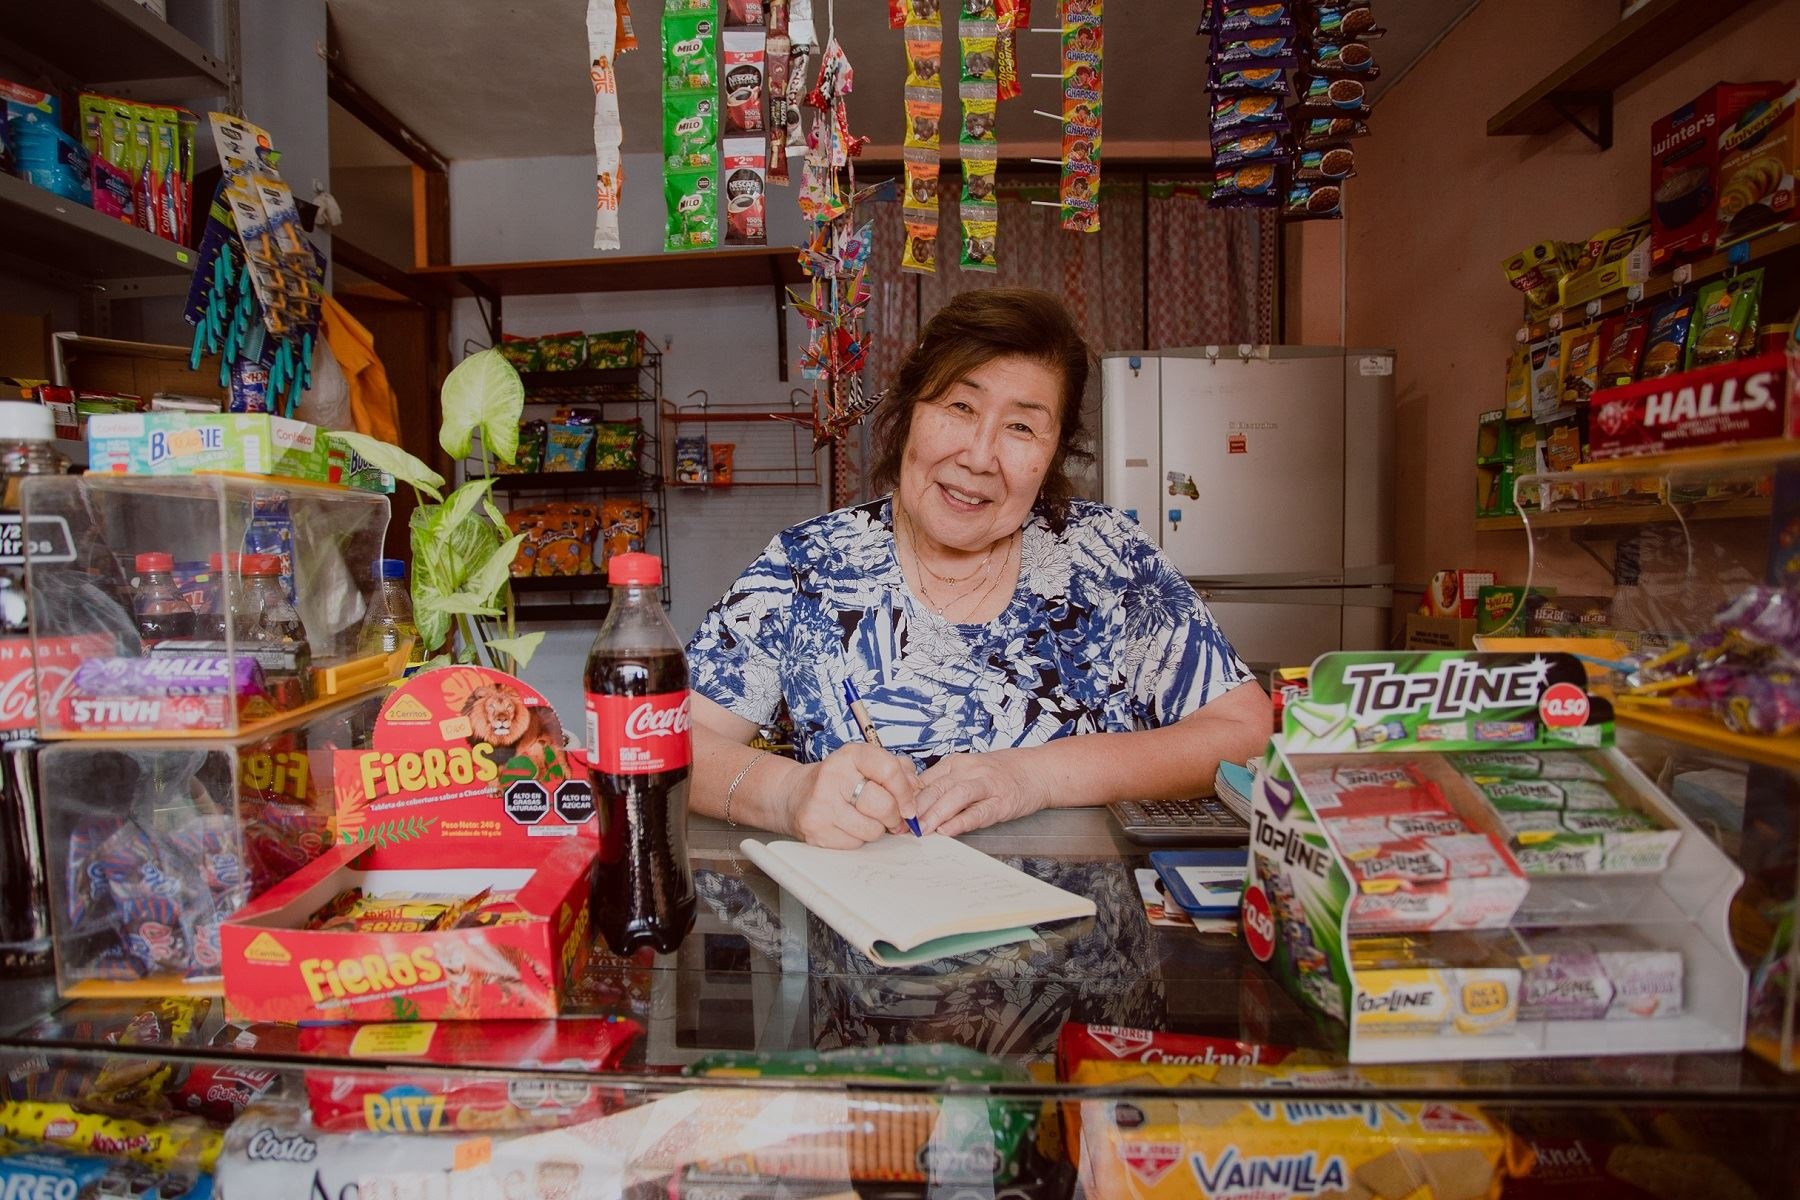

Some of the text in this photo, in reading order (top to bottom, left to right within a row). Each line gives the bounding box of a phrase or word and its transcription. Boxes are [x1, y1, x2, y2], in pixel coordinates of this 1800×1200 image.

[677, 44, 700, 53] MILO
[678, 122, 700, 132] MILO
[1653, 112, 1717, 156] winter's
[1725, 101, 1783, 147] Universal
[1643, 372, 1777, 427] HALLS
[142, 656, 231, 678] HALLS
[71, 700, 160, 723] HALLS
[390, 710, 428, 718] 2 Cerritos
[1255, 809, 1328, 878] TOPLINE
[363, 1093, 447, 1133] RITZ
[247, 1128, 318, 1164] Costa
[0, 1172, 79, 1200] REO
[1191, 1149, 1344, 1193] VAINILLA
